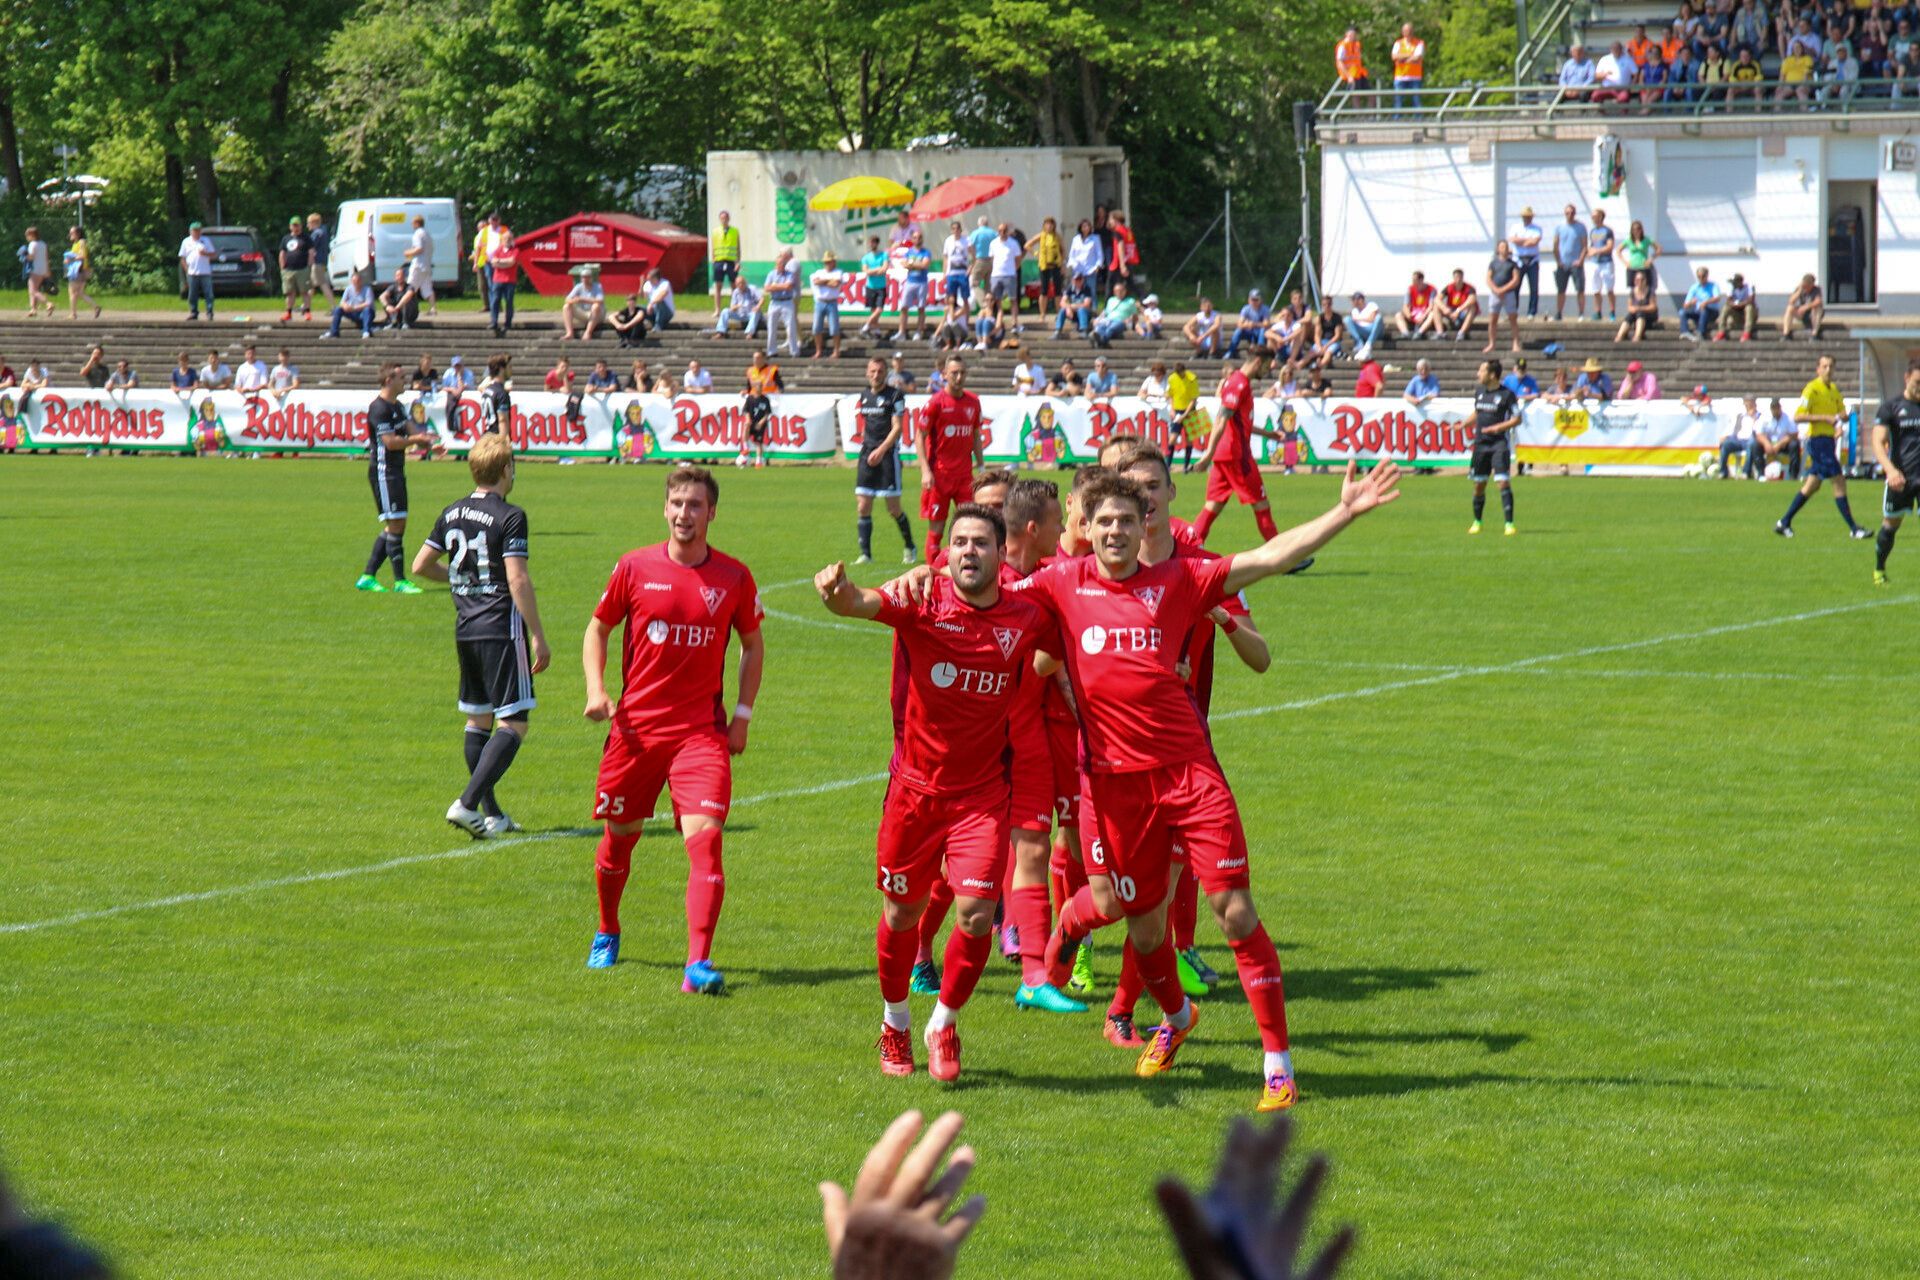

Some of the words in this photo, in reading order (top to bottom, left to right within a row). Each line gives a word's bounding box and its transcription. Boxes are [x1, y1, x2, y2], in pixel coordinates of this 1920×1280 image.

[40, 393, 165, 445] Rothaus
[241, 396, 370, 448] Rothaus
[453, 398, 586, 450] Rhaus
[671, 399, 807, 452] Rothus
[445, 528, 491, 586] 21
[644, 582, 672, 591] uhlsport
[671, 624, 716, 647] TBF
[935, 621, 965, 633] uhlsport
[1108, 627, 1162, 652] TBF
[959, 669, 1010, 695] TBF
[597, 791, 625, 815] 25
[881, 866, 908, 895] 28
[962, 878, 994, 889] uhlsport
